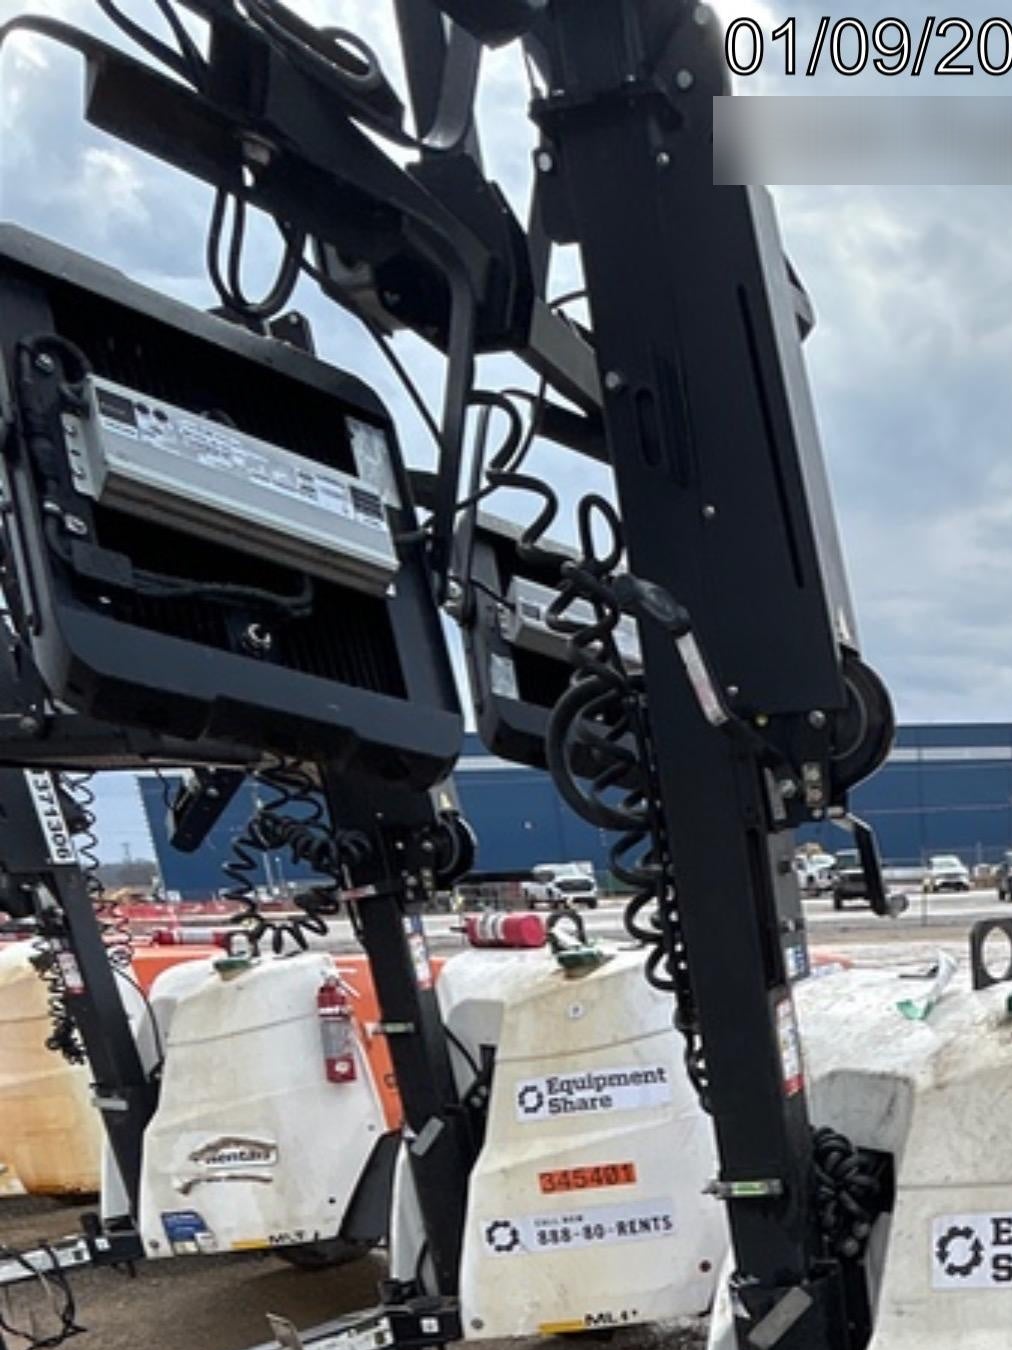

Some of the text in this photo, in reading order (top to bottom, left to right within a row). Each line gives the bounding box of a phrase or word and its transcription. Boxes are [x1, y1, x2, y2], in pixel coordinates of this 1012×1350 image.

[545, 1067, 667, 1095] Equipment
[548, 1094, 613, 1114] Share
[540, 1163, 635, 1194] 345401
[536, 1214, 673, 1246] 888-80-RENTS
